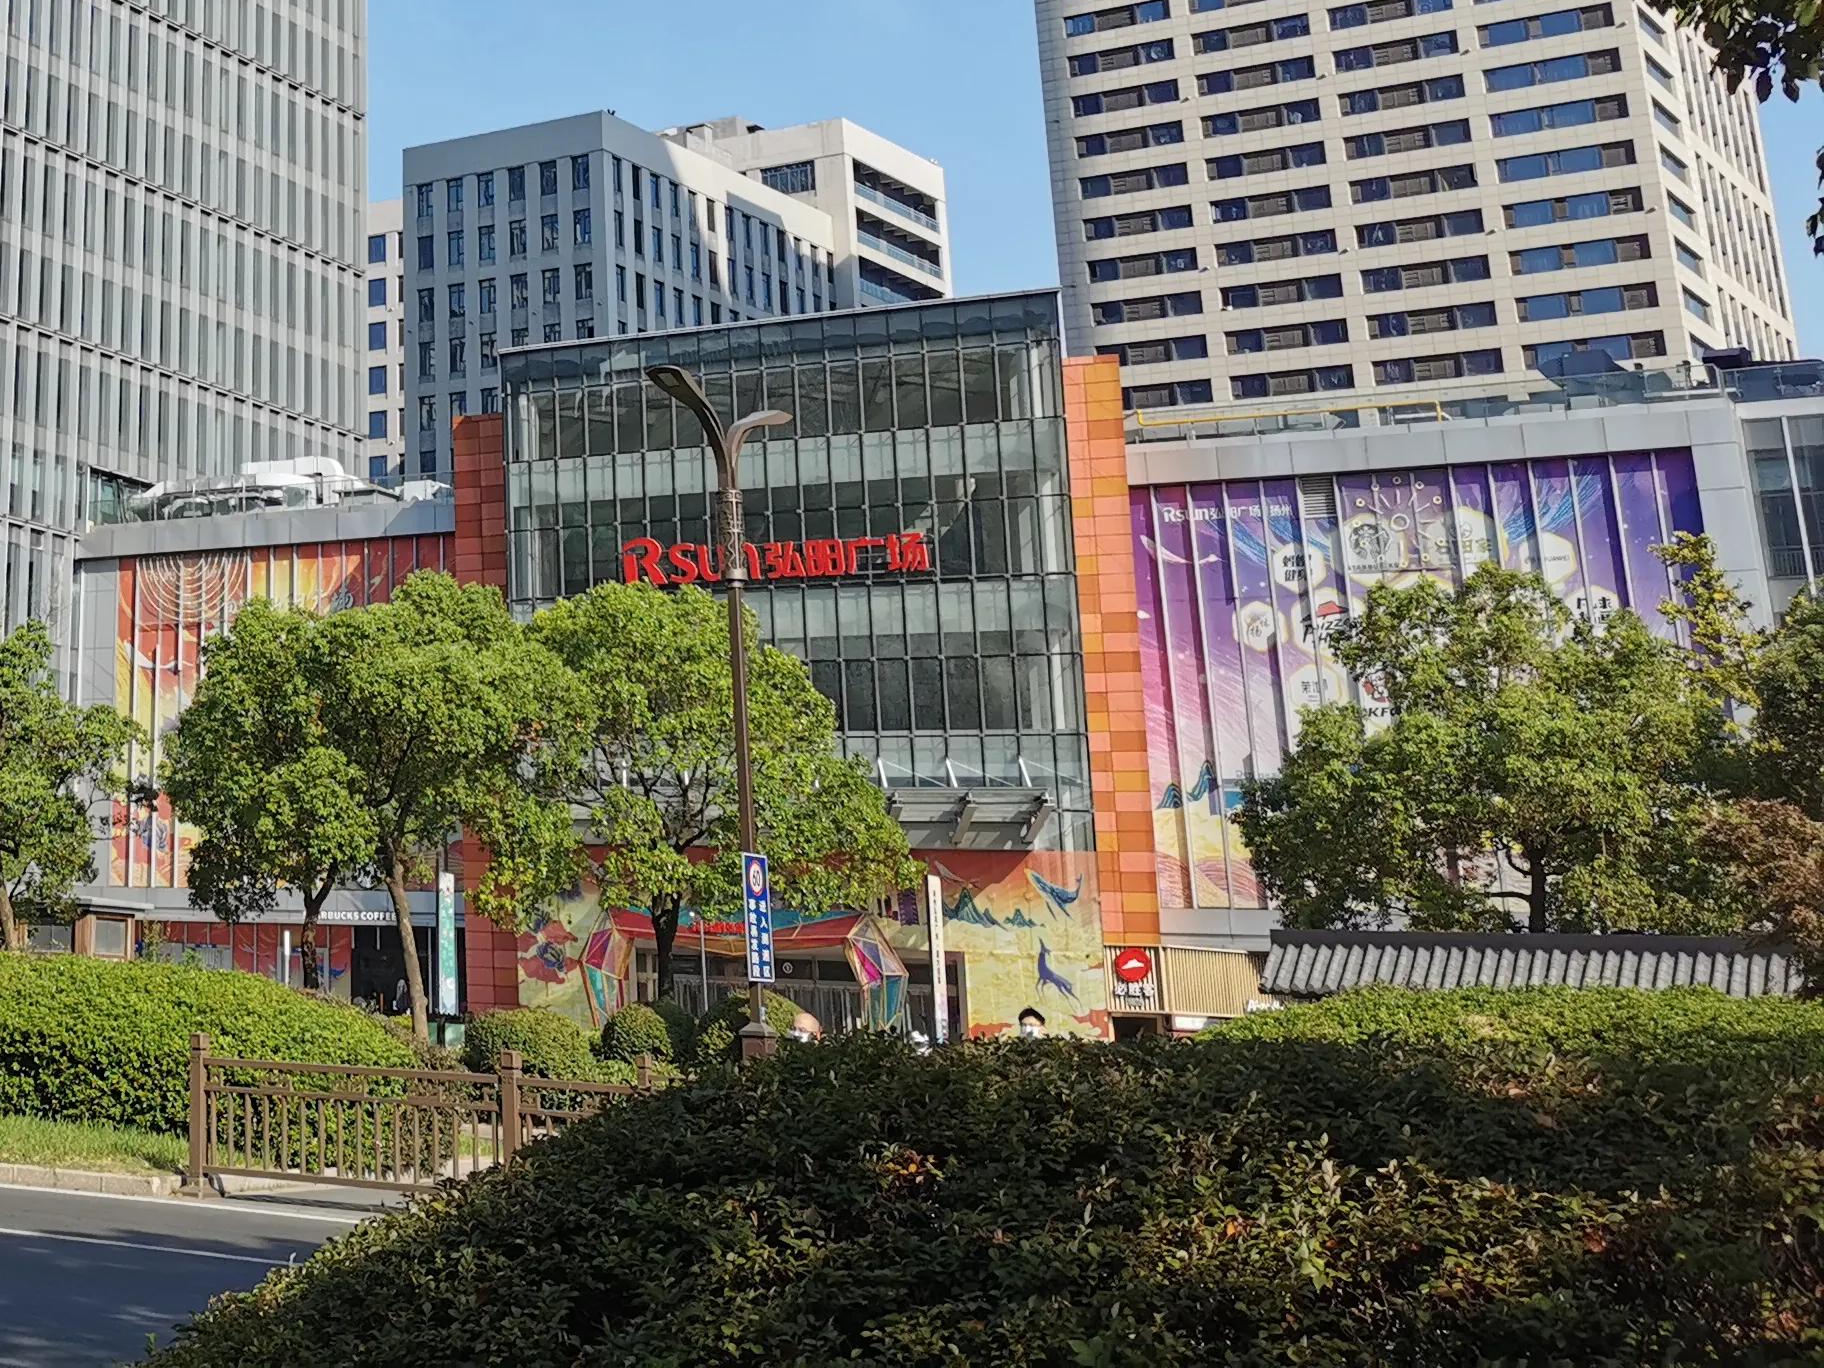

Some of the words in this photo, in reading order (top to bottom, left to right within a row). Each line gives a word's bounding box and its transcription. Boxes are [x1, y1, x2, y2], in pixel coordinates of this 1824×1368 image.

[763, 531, 930, 580] 弘阳广场
[752, 869, 761, 887] 60
